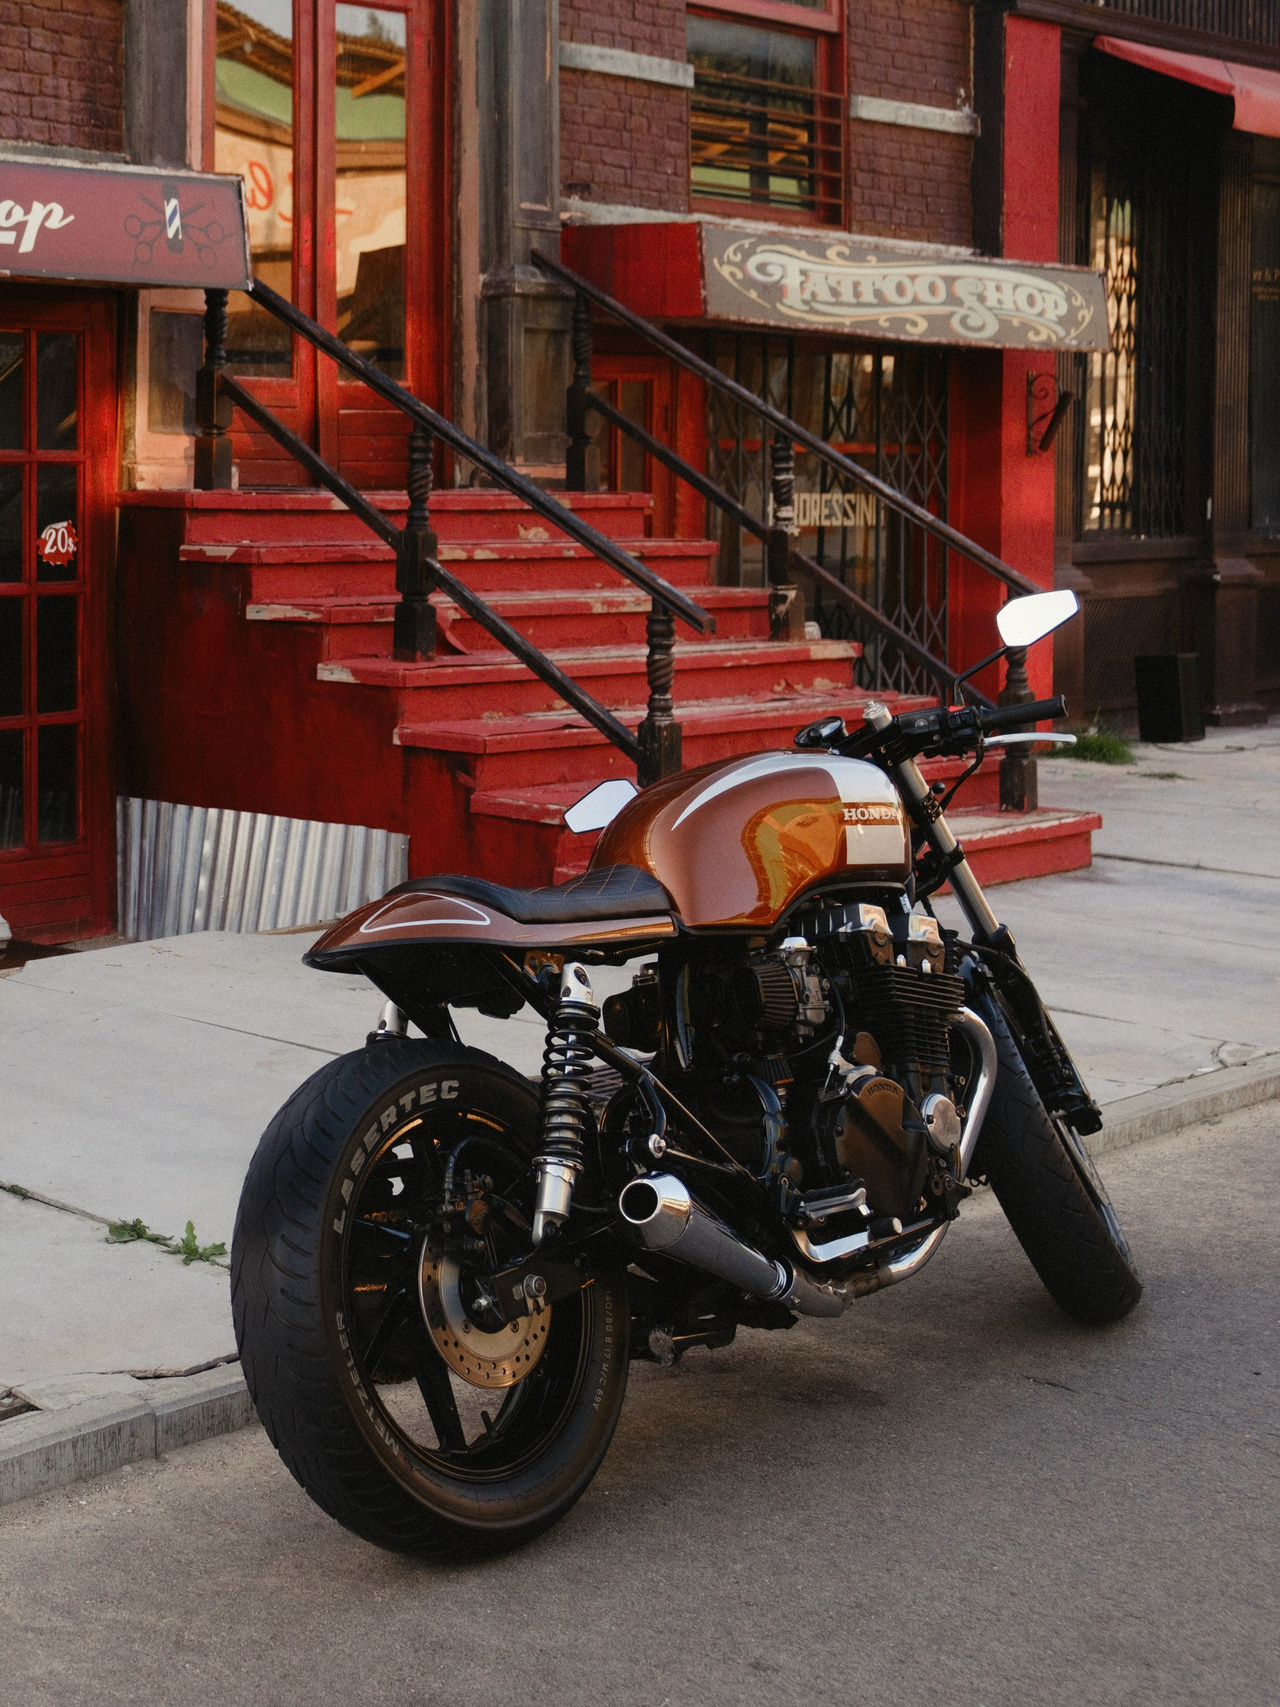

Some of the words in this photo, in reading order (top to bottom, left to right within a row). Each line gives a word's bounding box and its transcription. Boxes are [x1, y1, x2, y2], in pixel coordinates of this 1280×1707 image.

[842, 808, 901, 821] HONDA
[867, 1083, 898, 1096] HONDA
[333, 1080, 460, 1235] LASERTEC
[335, 1311, 400, 1457] METZELER
